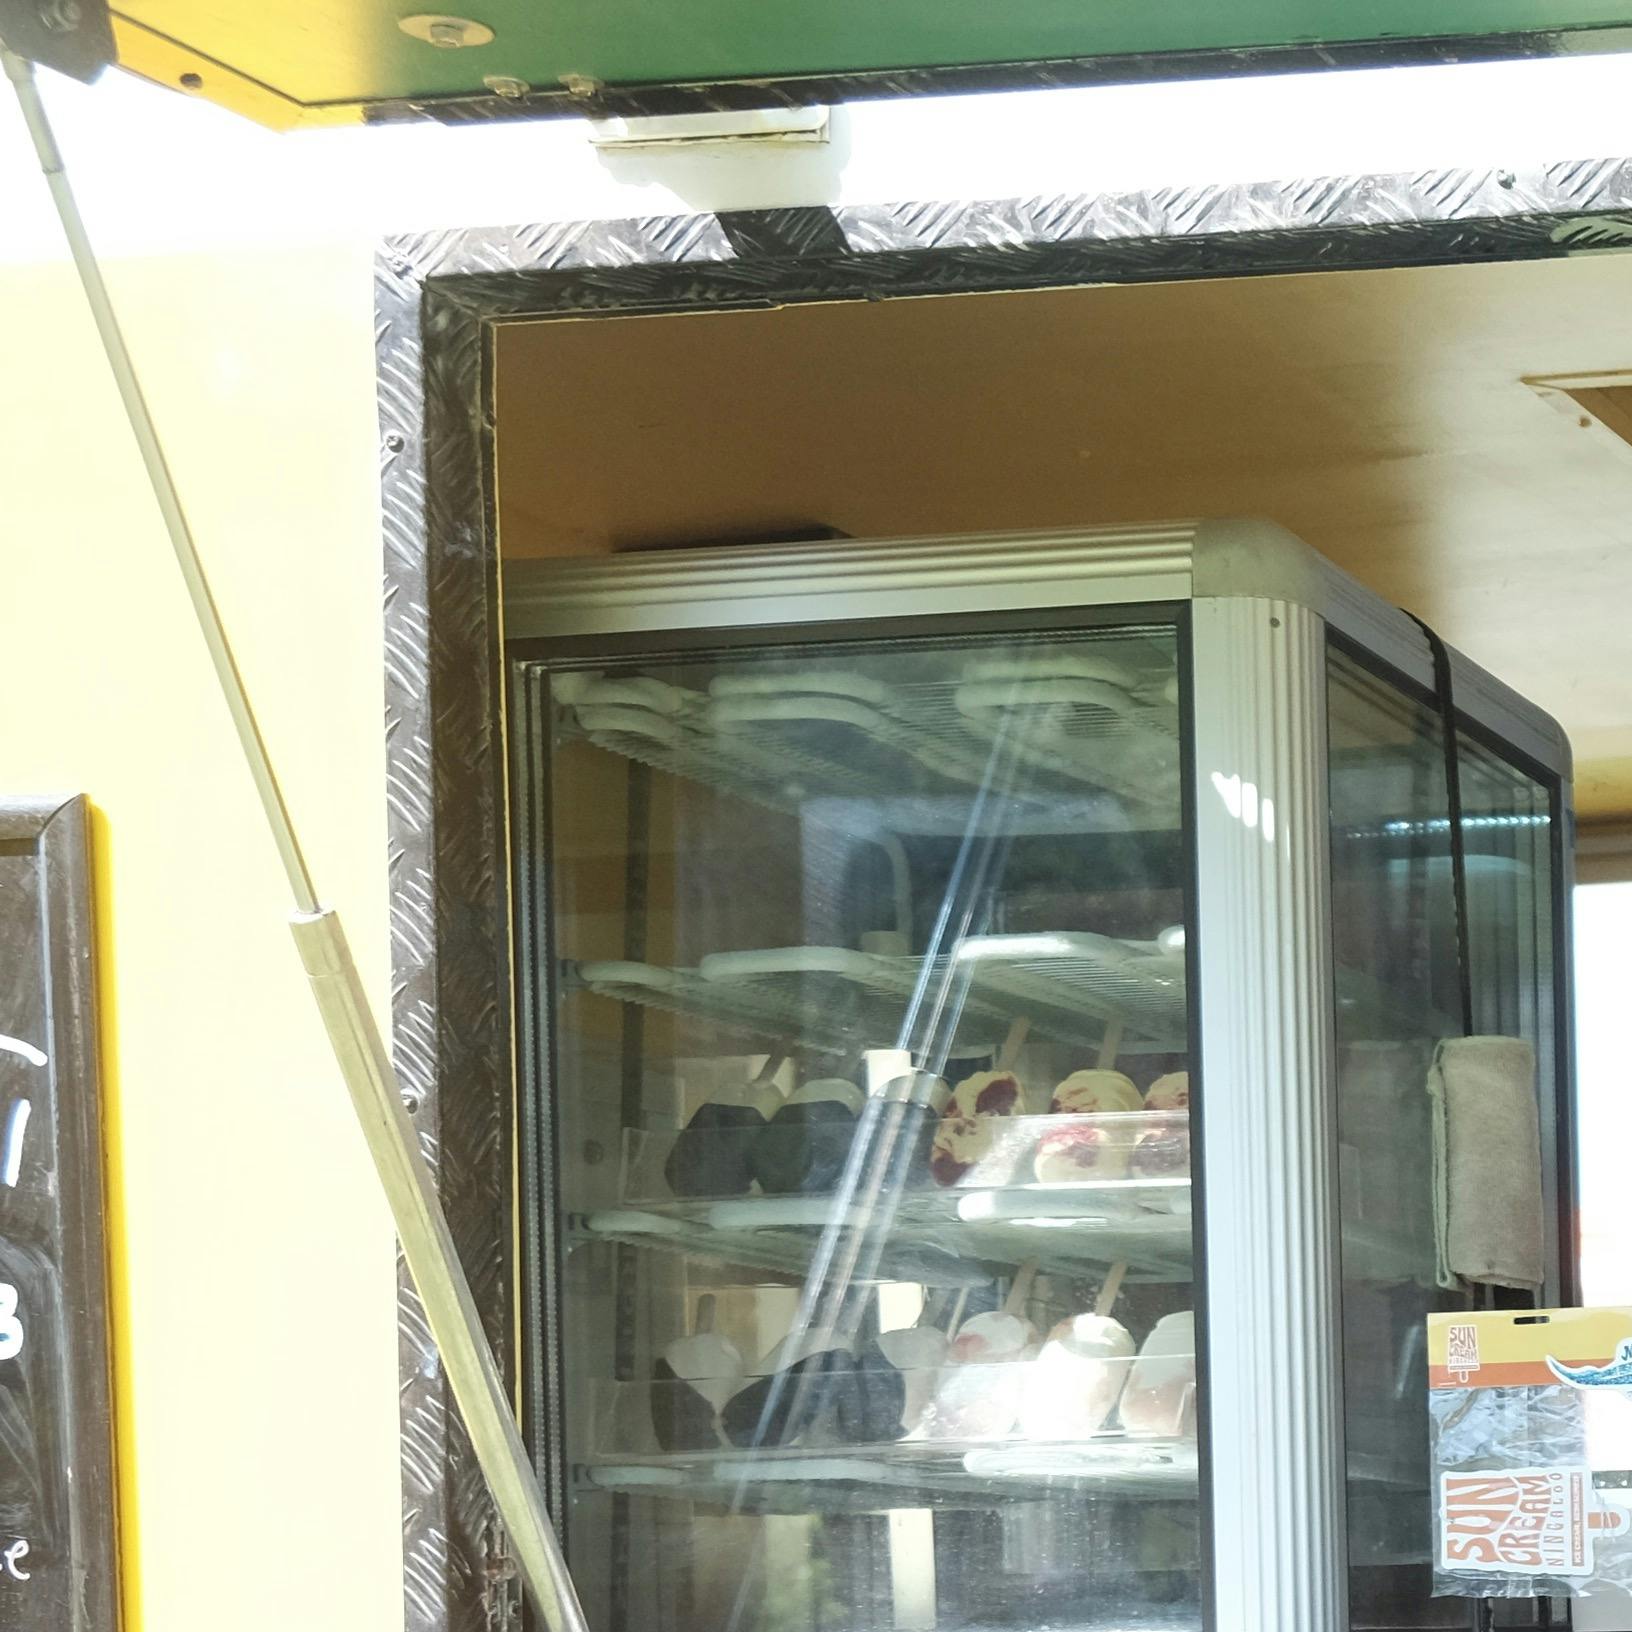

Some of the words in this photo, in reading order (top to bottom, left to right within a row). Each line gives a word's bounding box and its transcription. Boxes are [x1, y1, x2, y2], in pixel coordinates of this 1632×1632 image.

[1449, 1326, 1477, 1350] SUN
[1446, 1478, 1520, 1563] SUN
[1496, 1475, 1552, 1566] CREAM
[1543, 1472, 1565, 1567] NINGALOO
